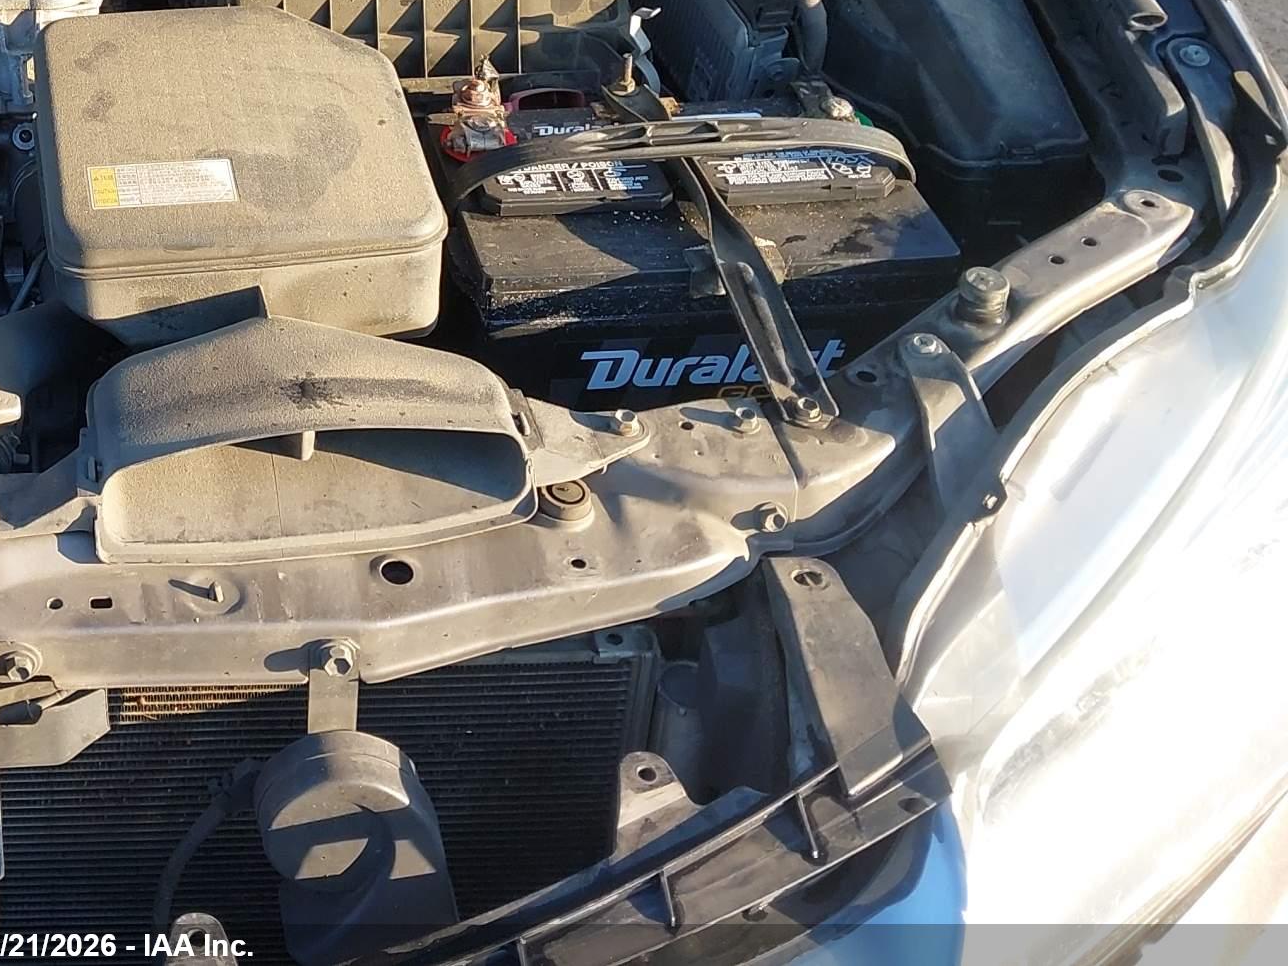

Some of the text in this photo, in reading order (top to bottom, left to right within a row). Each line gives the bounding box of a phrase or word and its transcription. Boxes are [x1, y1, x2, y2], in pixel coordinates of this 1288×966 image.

[533, 122, 620, 136] Dural
[580, 160, 624, 170] POISON
[580, 338, 846, 390] Duralt
